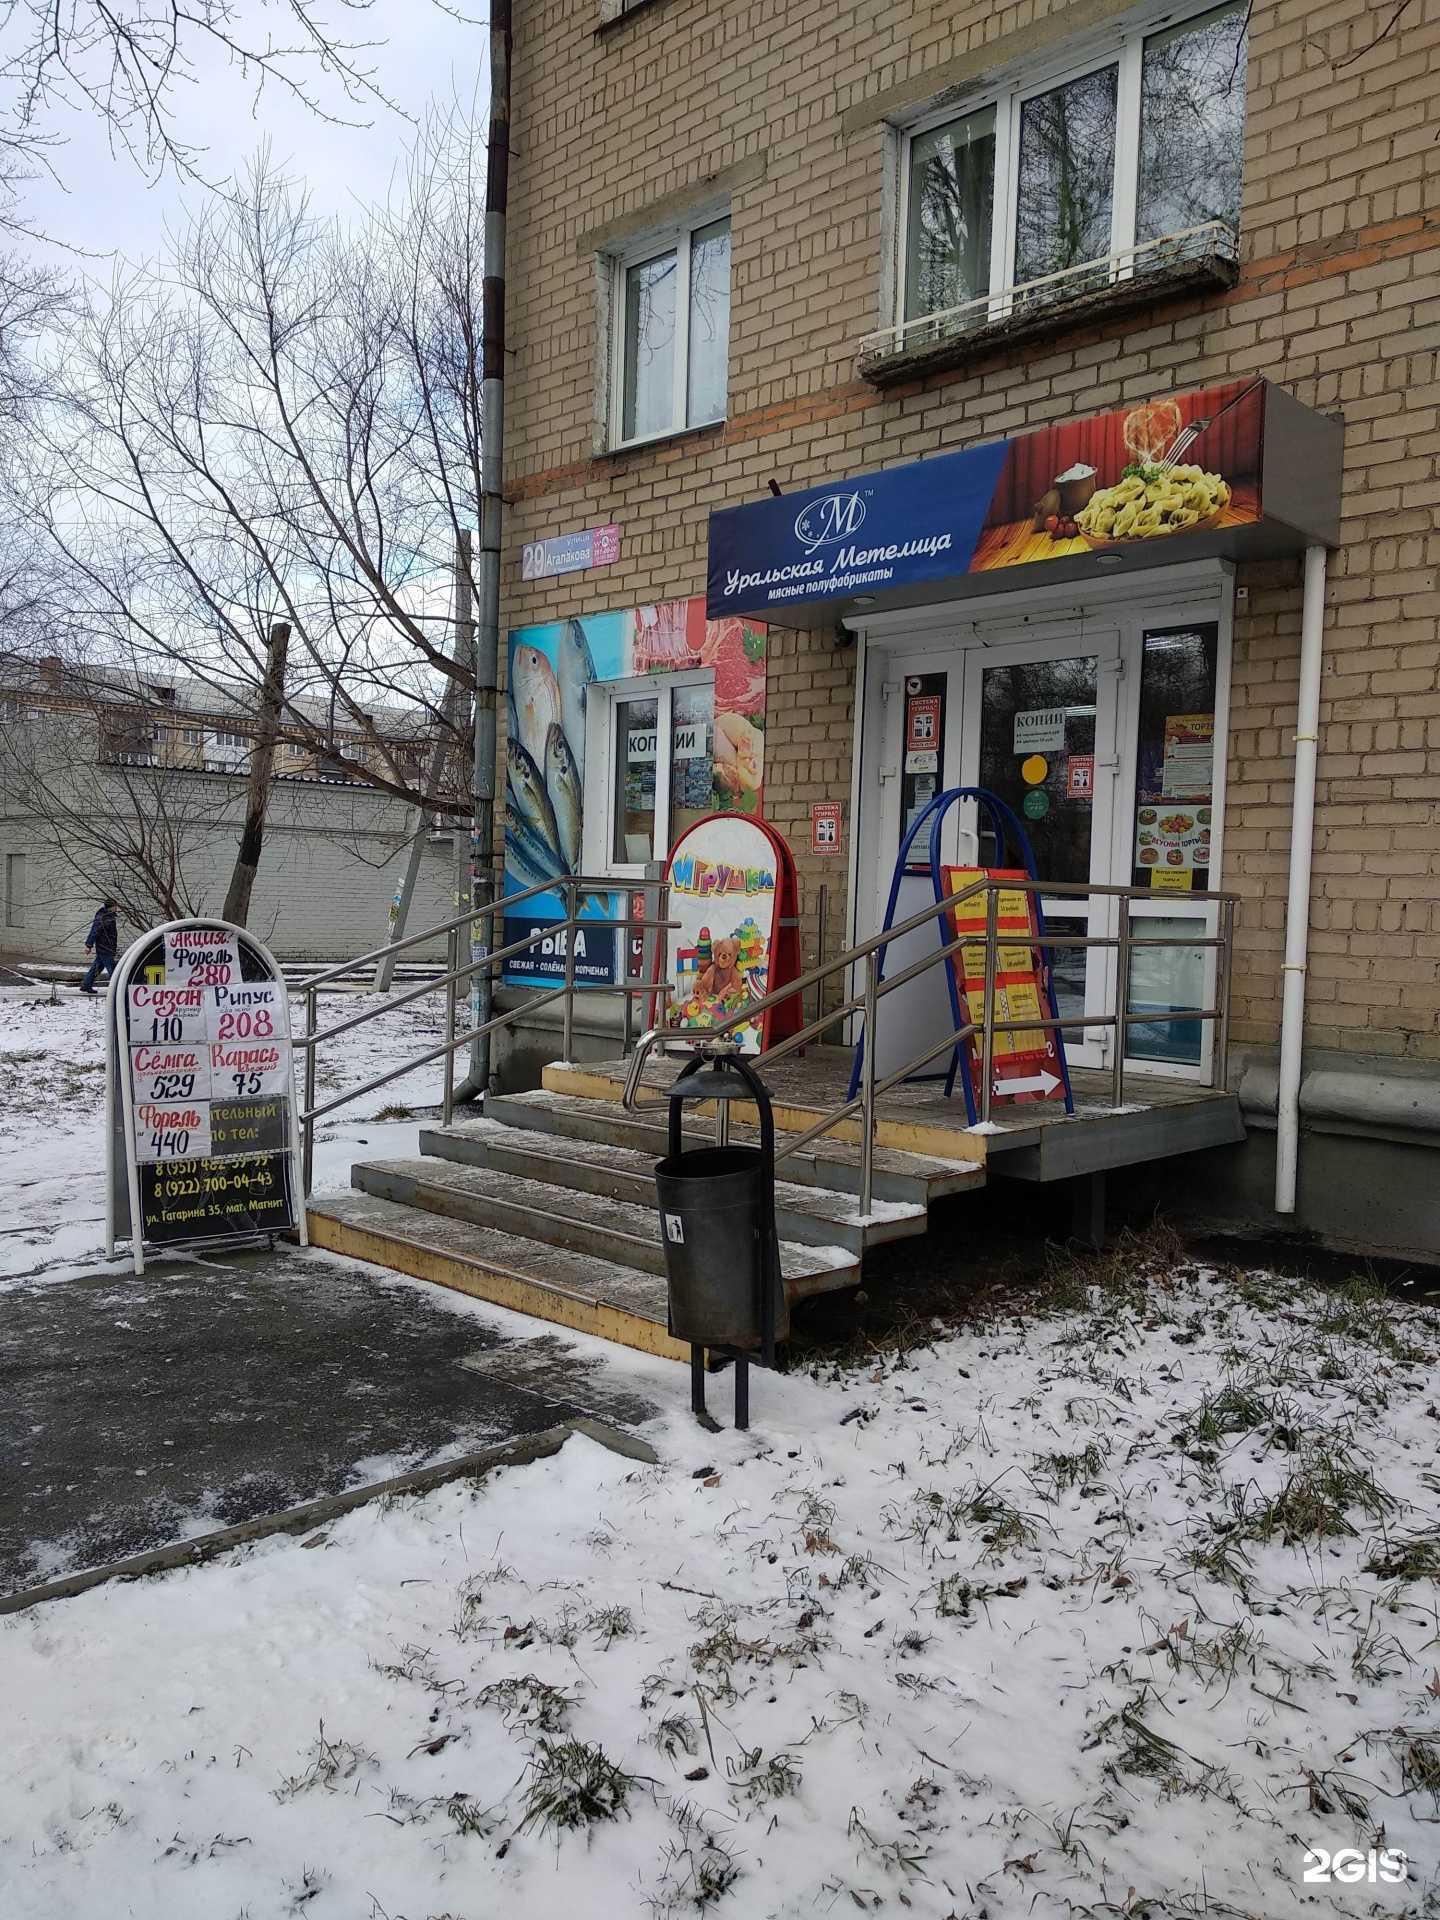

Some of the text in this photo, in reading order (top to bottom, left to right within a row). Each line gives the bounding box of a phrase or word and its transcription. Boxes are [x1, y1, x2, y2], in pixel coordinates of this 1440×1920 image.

[523, 543, 545, 579] 29
[723, 532, 952, 596] Уральская Метелица
[767, 567, 894, 600] мясные полуфабрикаты
[1017, 713, 1063, 727] КОПИИ
[172, 948, 233, 968] Форель
[509, 961, 535, 971] СВЕЖАЯ
[187, 964, 232, 987] 280
[132, 985, 204, 1018] Сазан
[214, 985, 275, 1007] Рипус
[150, 1017, 183, 1041] 110
[218, 1009, 274, 1040] 208
[134, 1047, 199, 1072] Сёмга
[211, 1044, 280, 1073] Карась
[150, 1073, 196, 1100] 529
[232, 1071, 264, 1096] 75
[138, 1103, 202, 1135] Форель
[150, 1129, 190, 1158] 440
[231, 1127, 259, 1140] тел:
[154, 1171, 273, 1198] 8 (922) 700-04-43
[146, 1215, 159, 1226] ул.
[161, 1208, 206, 1222] Гагарина
[248, 1198, 285, 1211] Магнит
